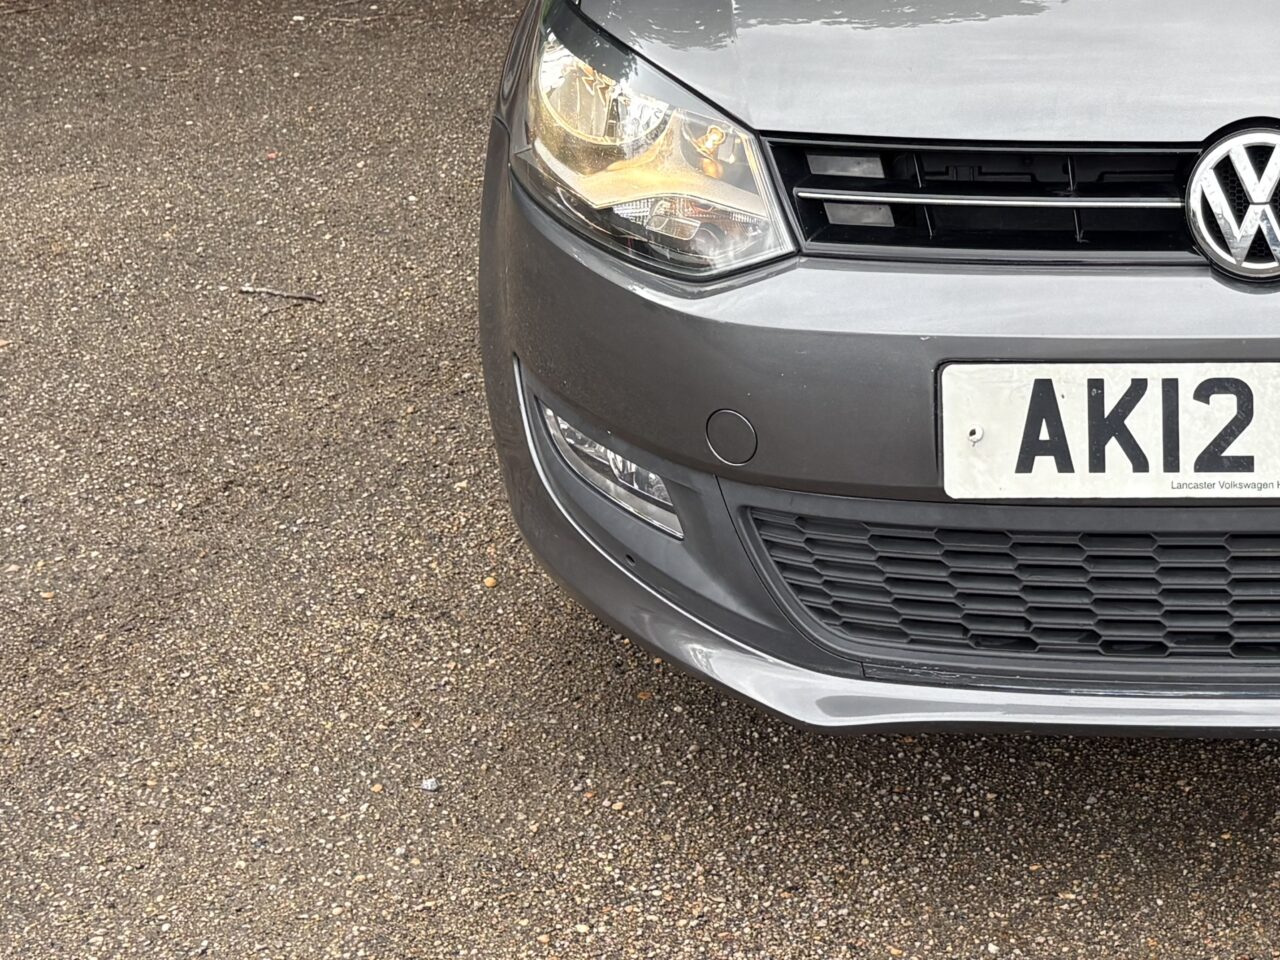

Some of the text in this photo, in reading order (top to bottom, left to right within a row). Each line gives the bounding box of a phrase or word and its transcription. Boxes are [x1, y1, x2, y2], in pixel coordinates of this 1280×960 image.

[1014, 377, 1256, 474] AK12
[1171, 480, 1216, 490] Lancaster
[1218, 480, 1275, 492] Volkswagen
